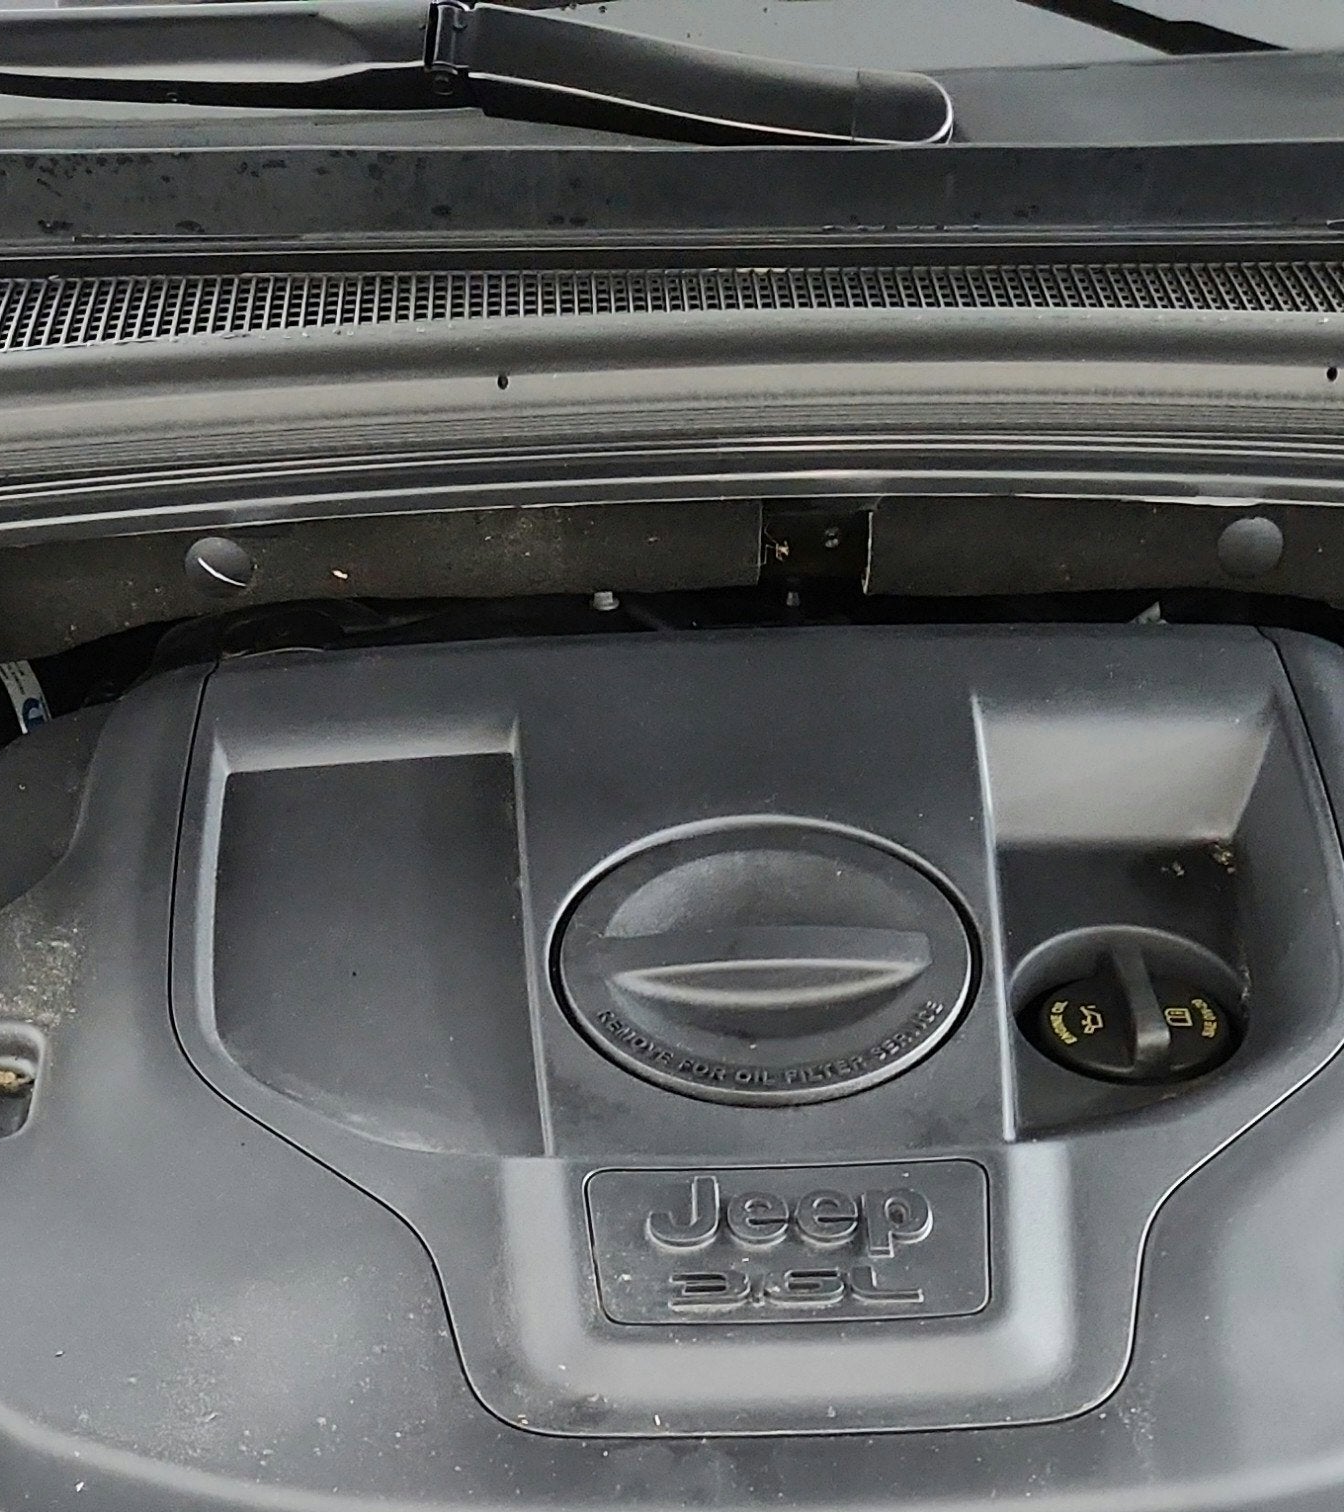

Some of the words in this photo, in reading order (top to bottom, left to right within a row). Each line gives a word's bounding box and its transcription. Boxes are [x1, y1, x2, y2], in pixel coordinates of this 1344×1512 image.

[596, 1009, 674, 1066] REMOVE
[678, 1057, 727, 1082] FOR
[734, 1070, 777, 1085] OIL
[785, 1055, 865, 1084] FILTER
[869, 999, 946, 1062] SERVICE
[644, 1175, 934, 1259] Jeep
[667, 1265, 925, 1313] 3.6L
